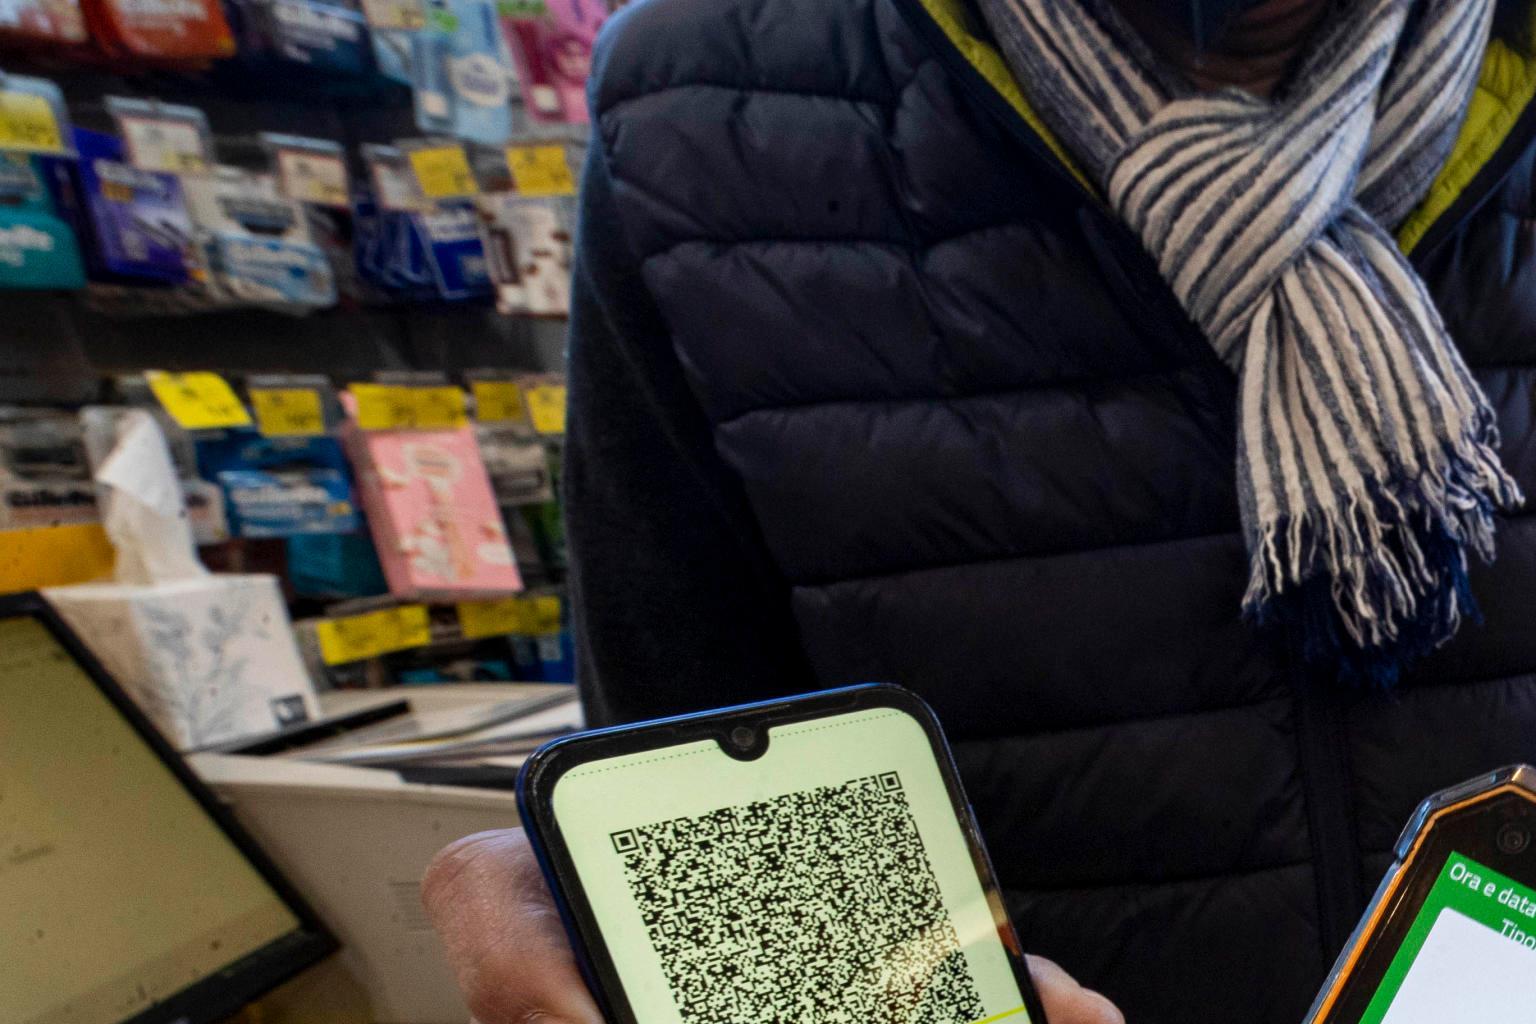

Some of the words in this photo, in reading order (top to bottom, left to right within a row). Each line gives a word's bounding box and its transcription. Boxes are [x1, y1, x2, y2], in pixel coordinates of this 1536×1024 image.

[1449, 862, 1481, 890] Ora
[1483, 882, 1496, 897] e
[1497, 888, 1536, 917] data
